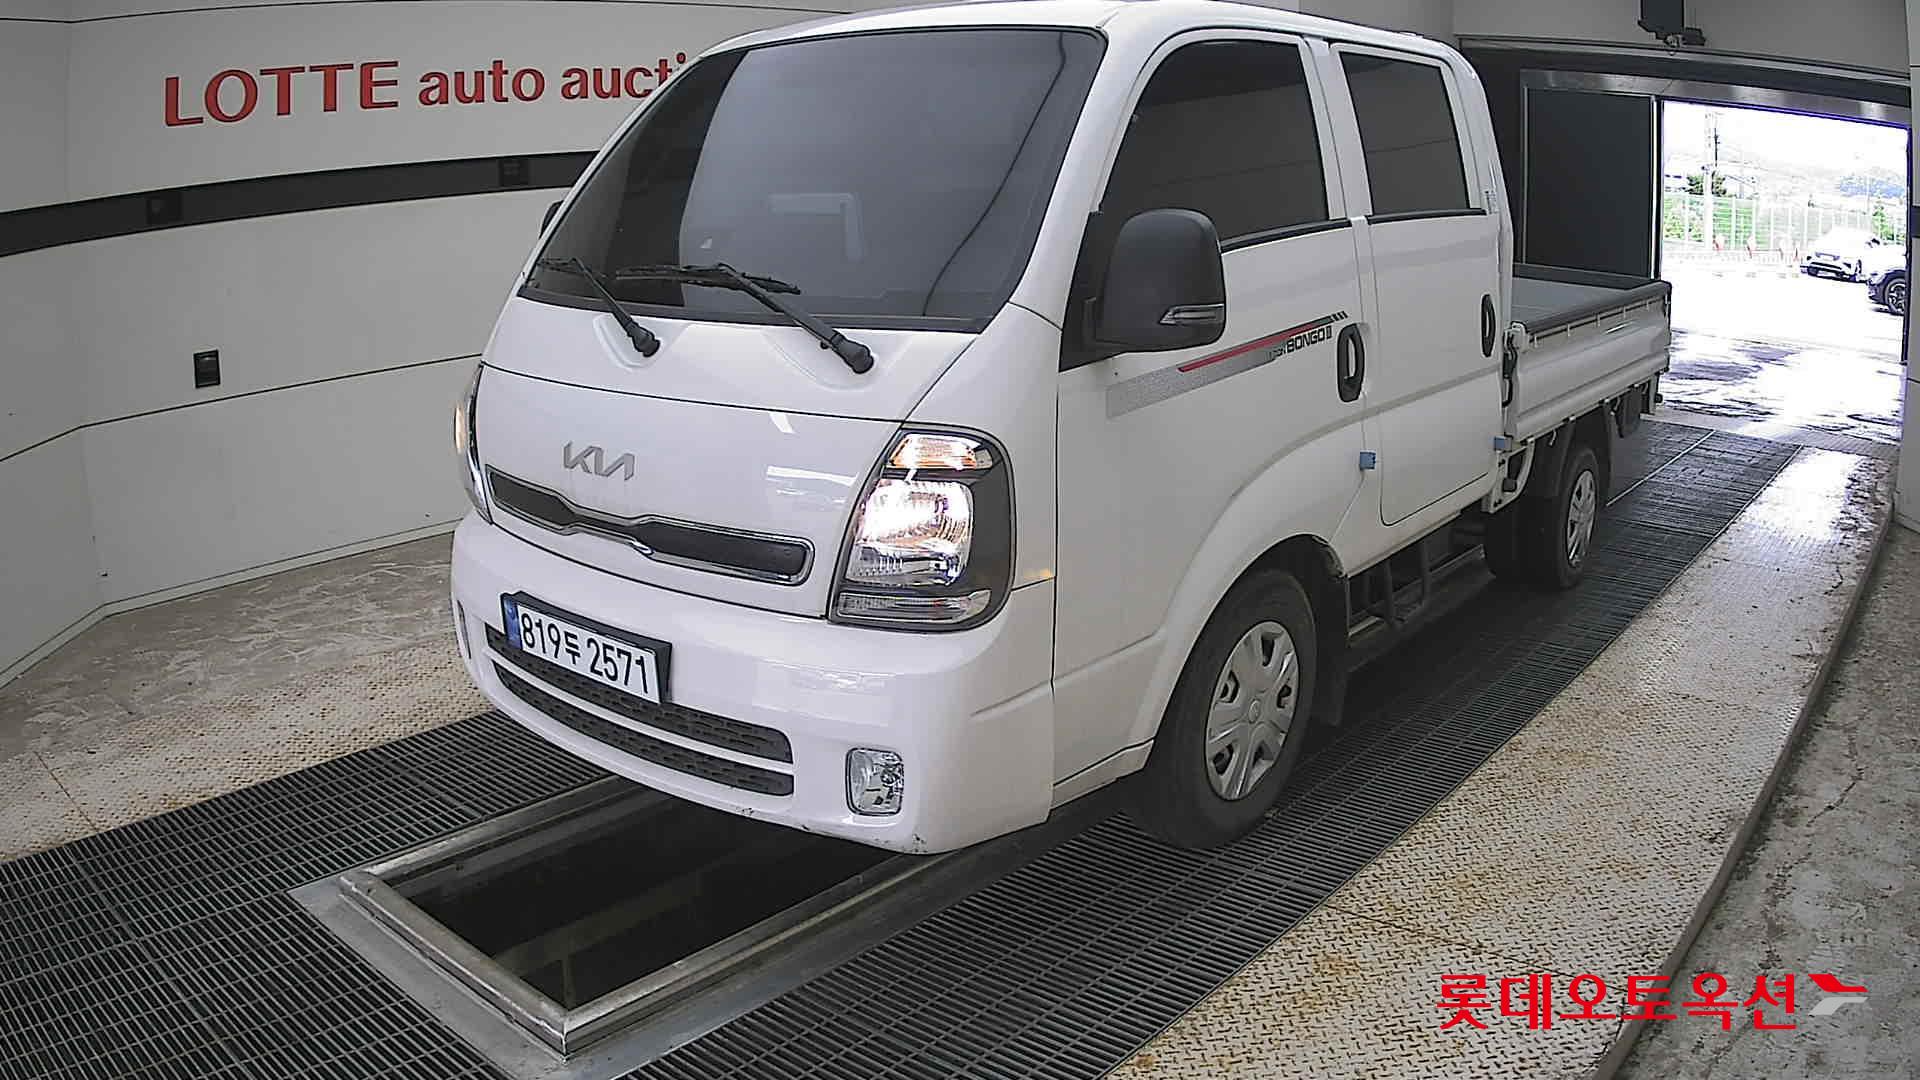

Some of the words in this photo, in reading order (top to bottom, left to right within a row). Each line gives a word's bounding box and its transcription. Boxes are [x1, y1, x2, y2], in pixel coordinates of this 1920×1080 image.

[164, 60, 400, 127] LOTTE
[417, 59, 545, 107] auto
[562, 440, 635, 481] KIA
[586, 637, 649, 694] 2571
